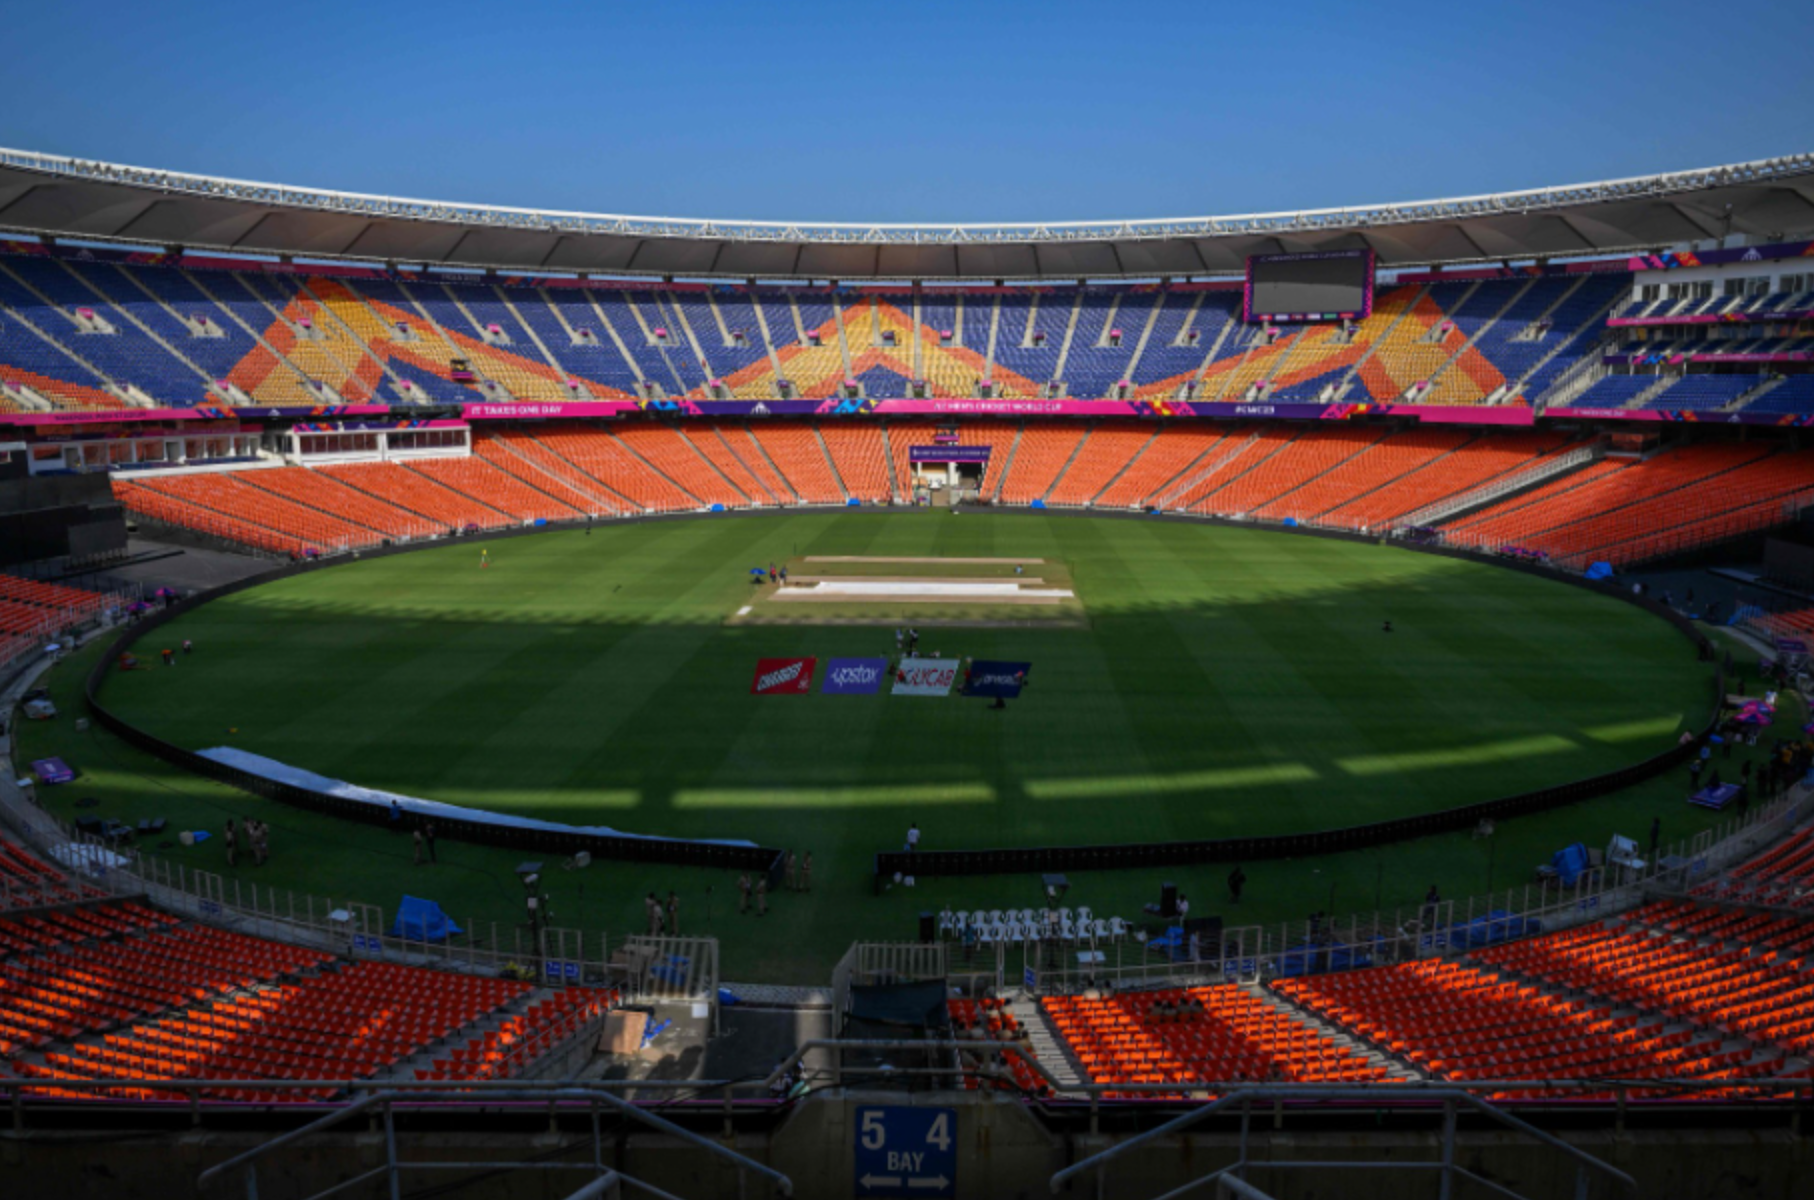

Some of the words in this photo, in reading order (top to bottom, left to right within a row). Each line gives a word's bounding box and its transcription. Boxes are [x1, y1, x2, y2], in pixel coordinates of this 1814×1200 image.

[471, 406, 482, 415] IT
[484, 405, 517, 415] TAKES
[518, 405, 539, 414] ONE
[541, 405, 563, 414] DAY
[976, 402, 1010, 411] CRICKET
[1012, 402, 1043, 411] WORLD
[1044, 402, 1062, 411] CUP
[861, 1110, 886, 1150] 5
[925, 1112, 951, 1151] 4
[887, 1151, 924, 1172] BAY
